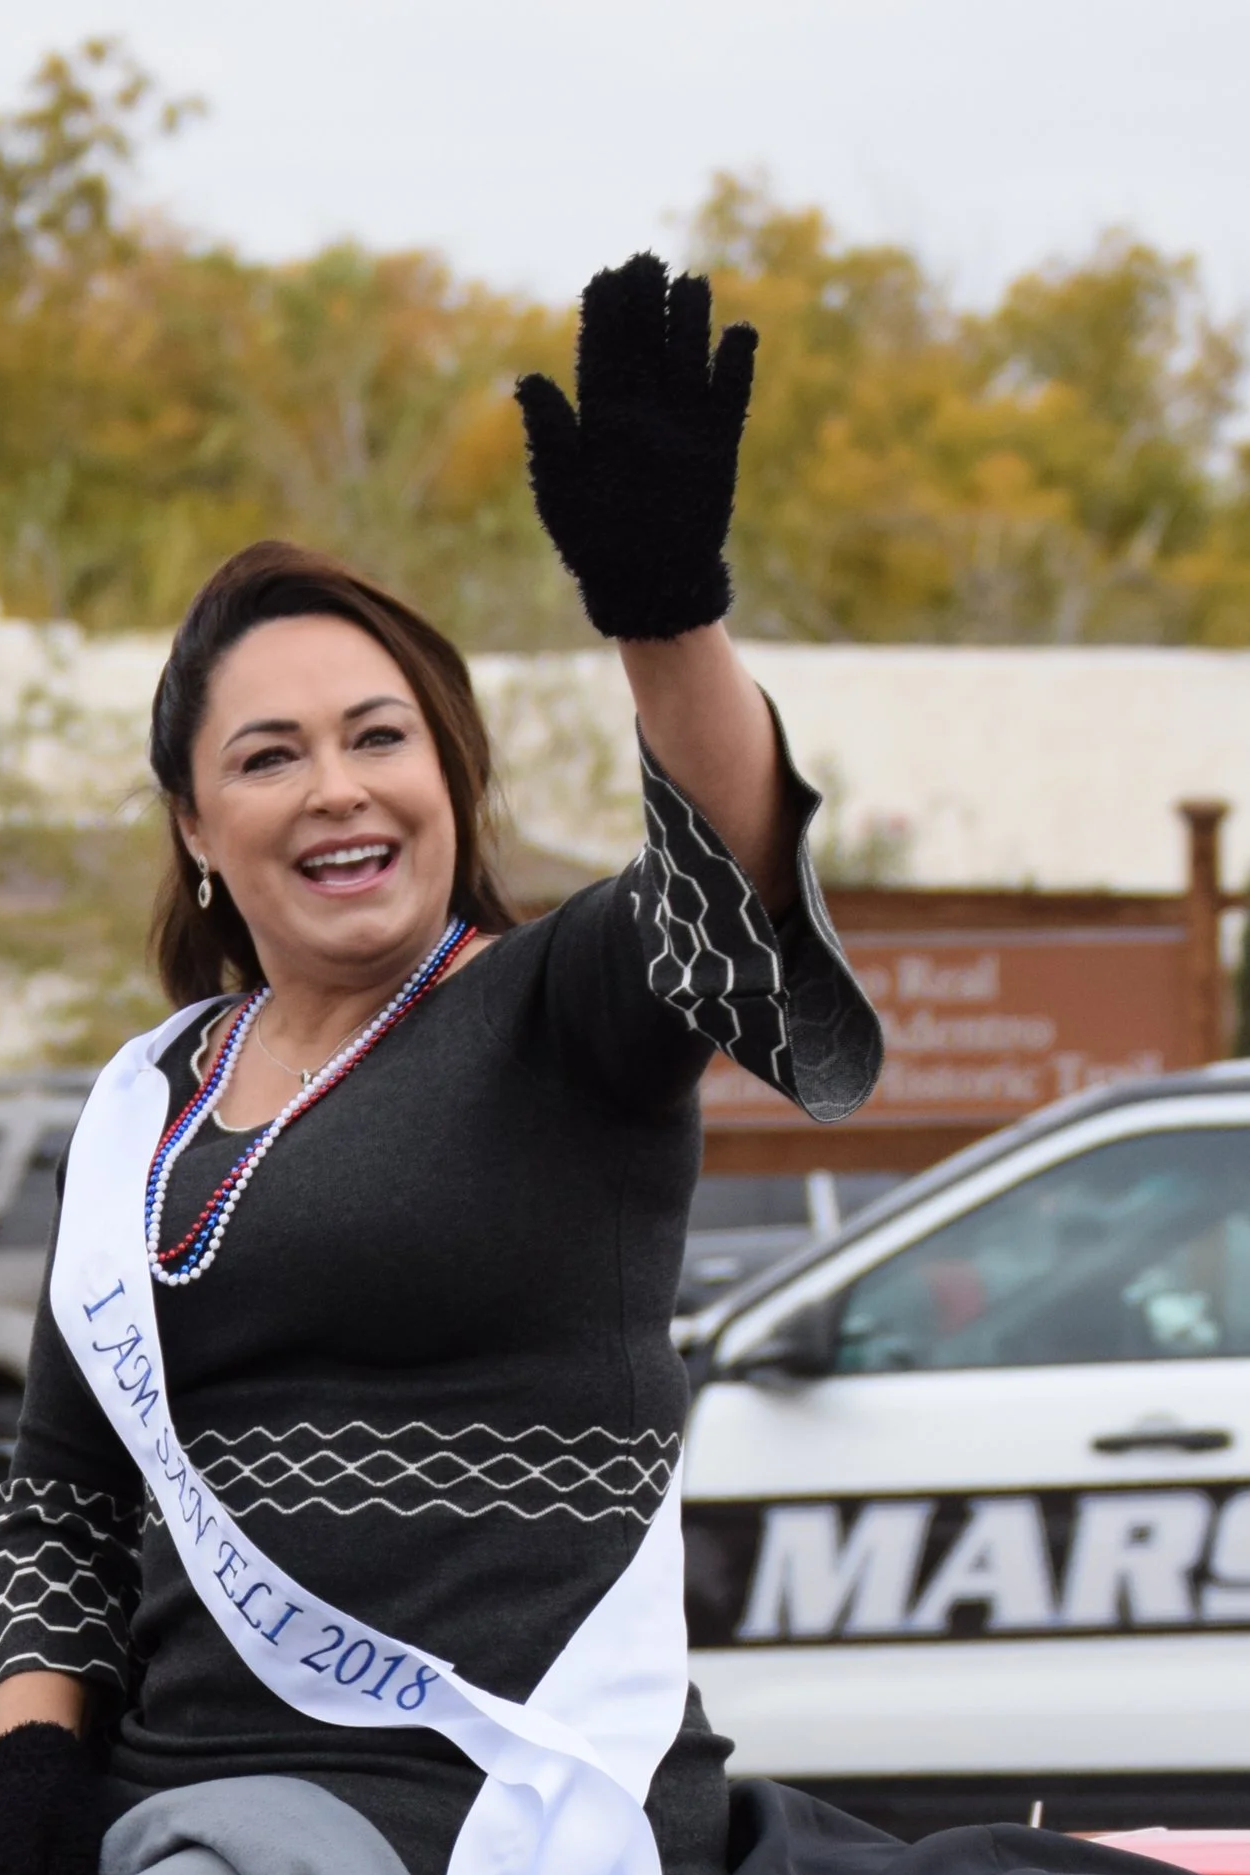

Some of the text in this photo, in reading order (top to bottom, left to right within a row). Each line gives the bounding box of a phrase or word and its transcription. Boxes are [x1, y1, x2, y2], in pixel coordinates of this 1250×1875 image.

[83, 1279, 440, 1711] I AM SAN ELI 2018
